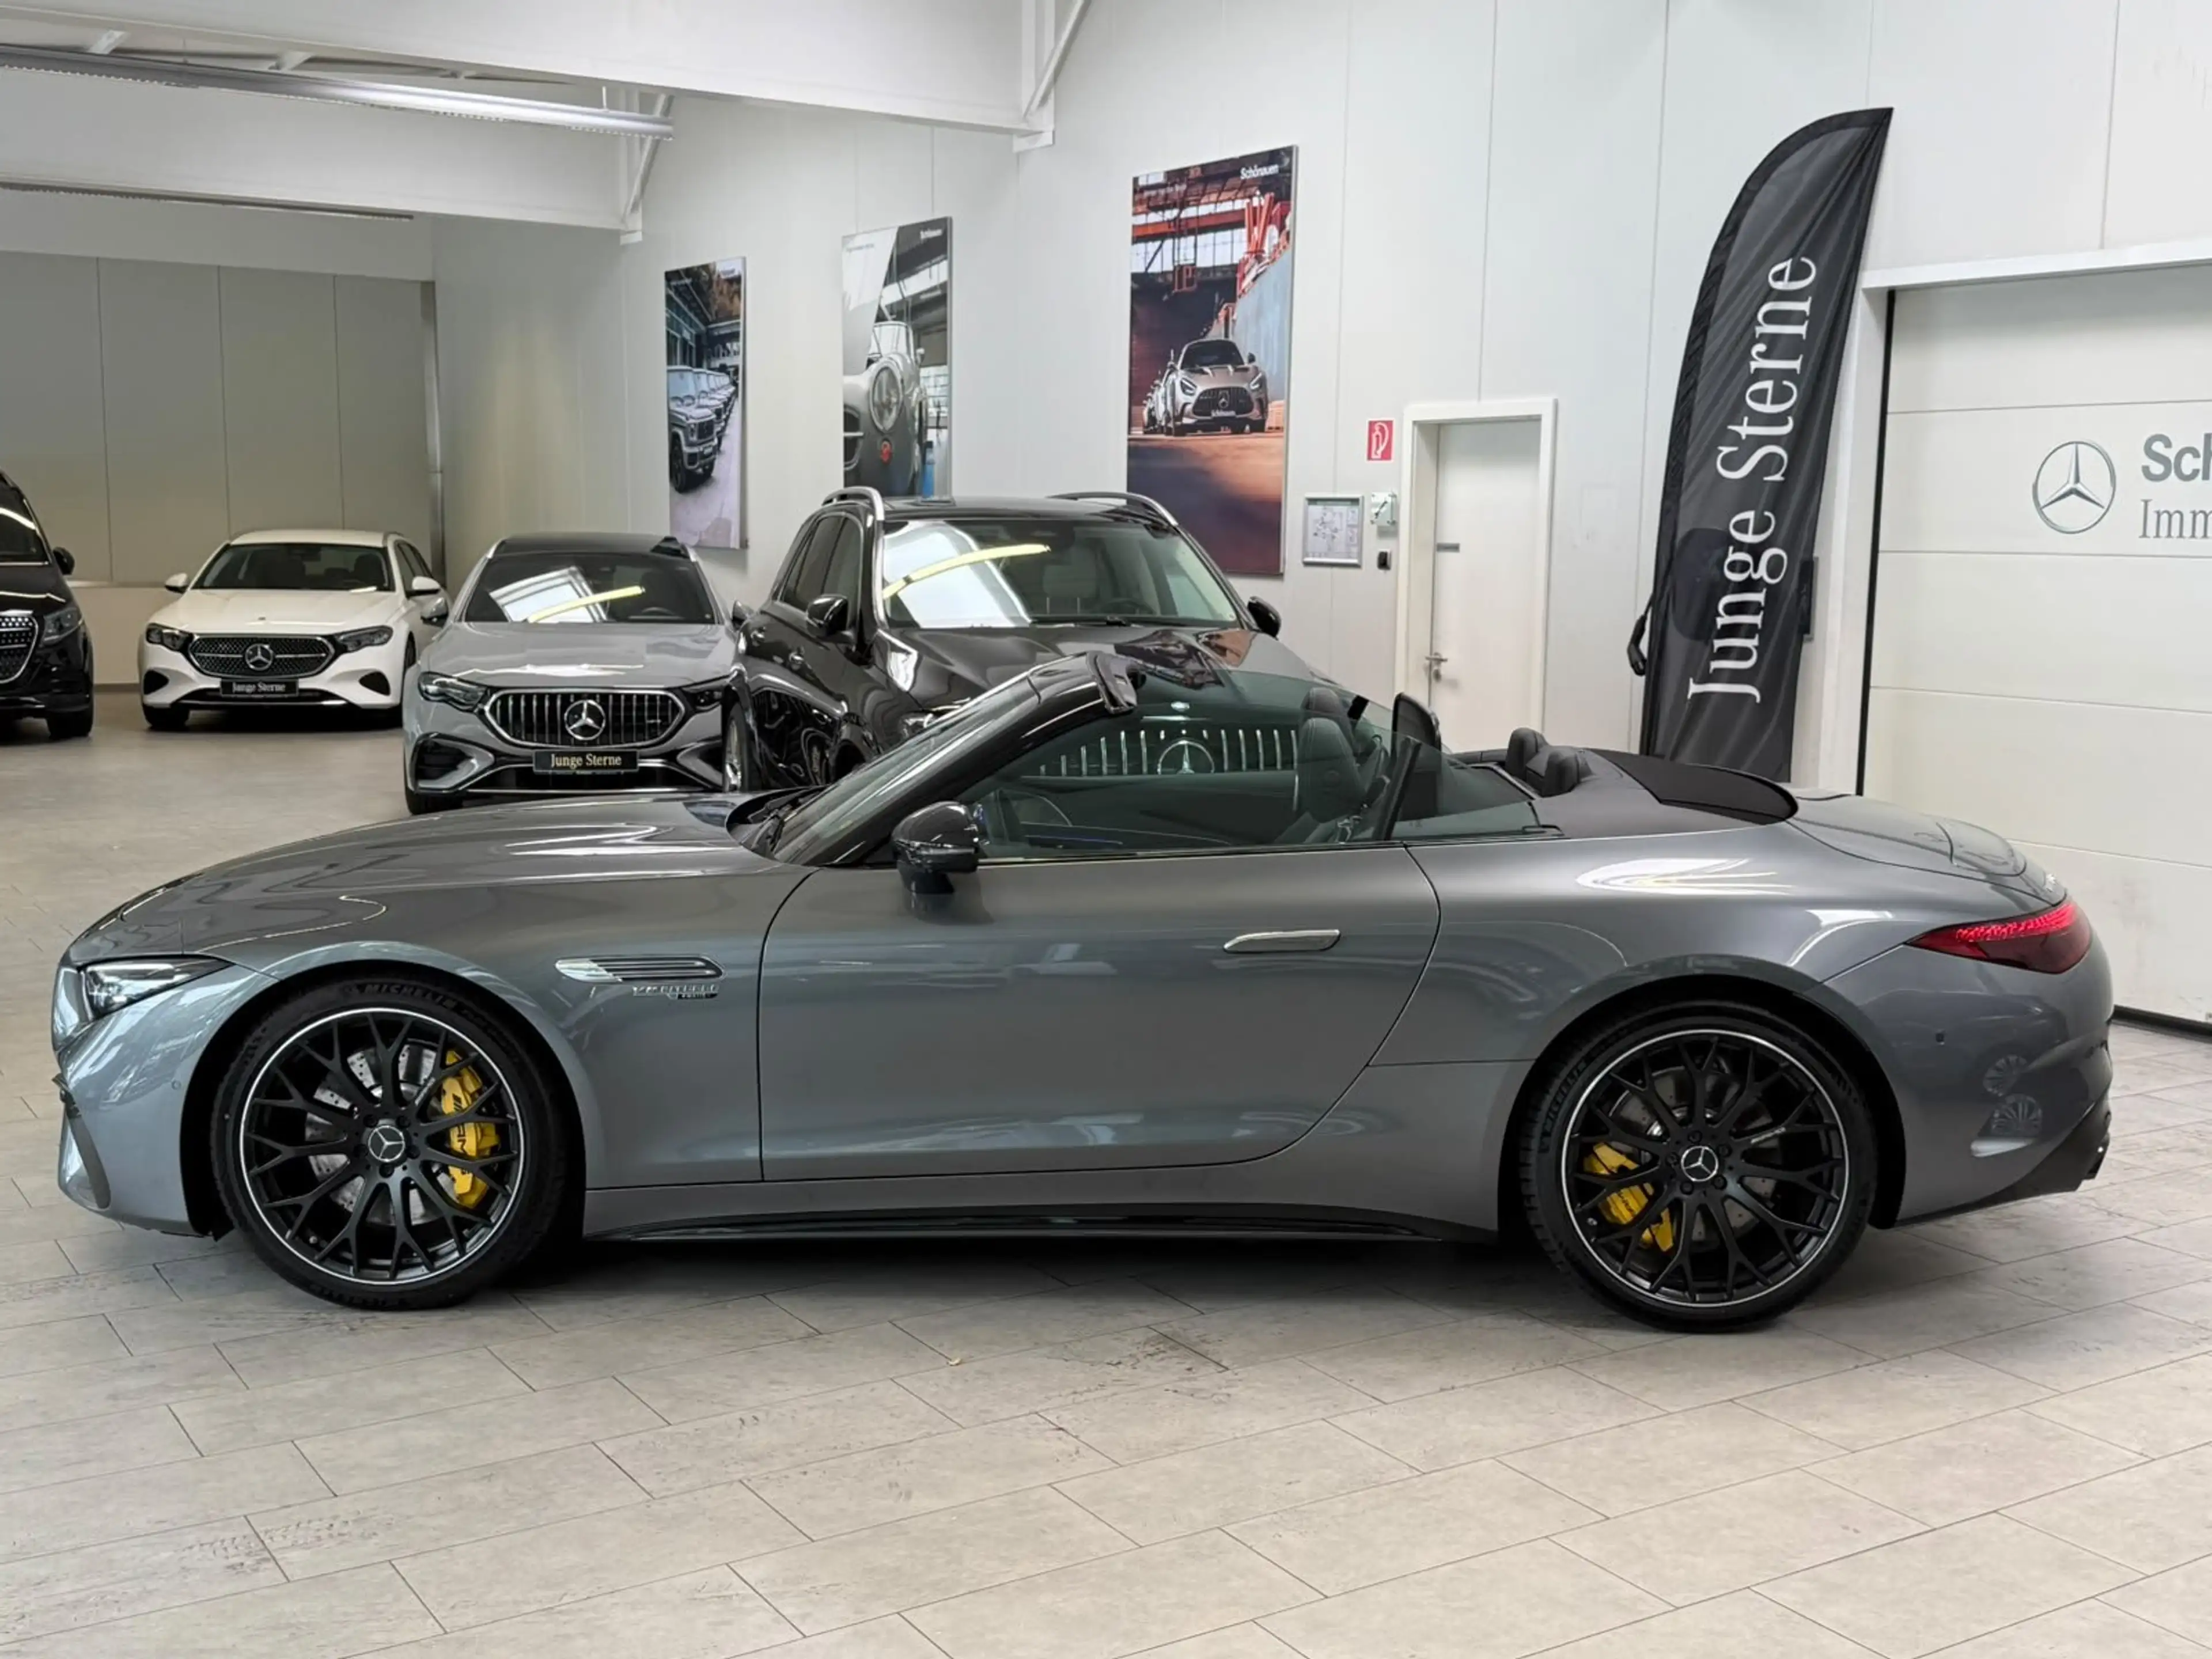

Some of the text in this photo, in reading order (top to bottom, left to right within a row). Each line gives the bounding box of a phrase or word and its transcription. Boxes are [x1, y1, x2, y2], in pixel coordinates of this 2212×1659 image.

[1687, 256, 1817, 704] Junge Sterne
[551, 753, 622, 769] Junge Sterne
